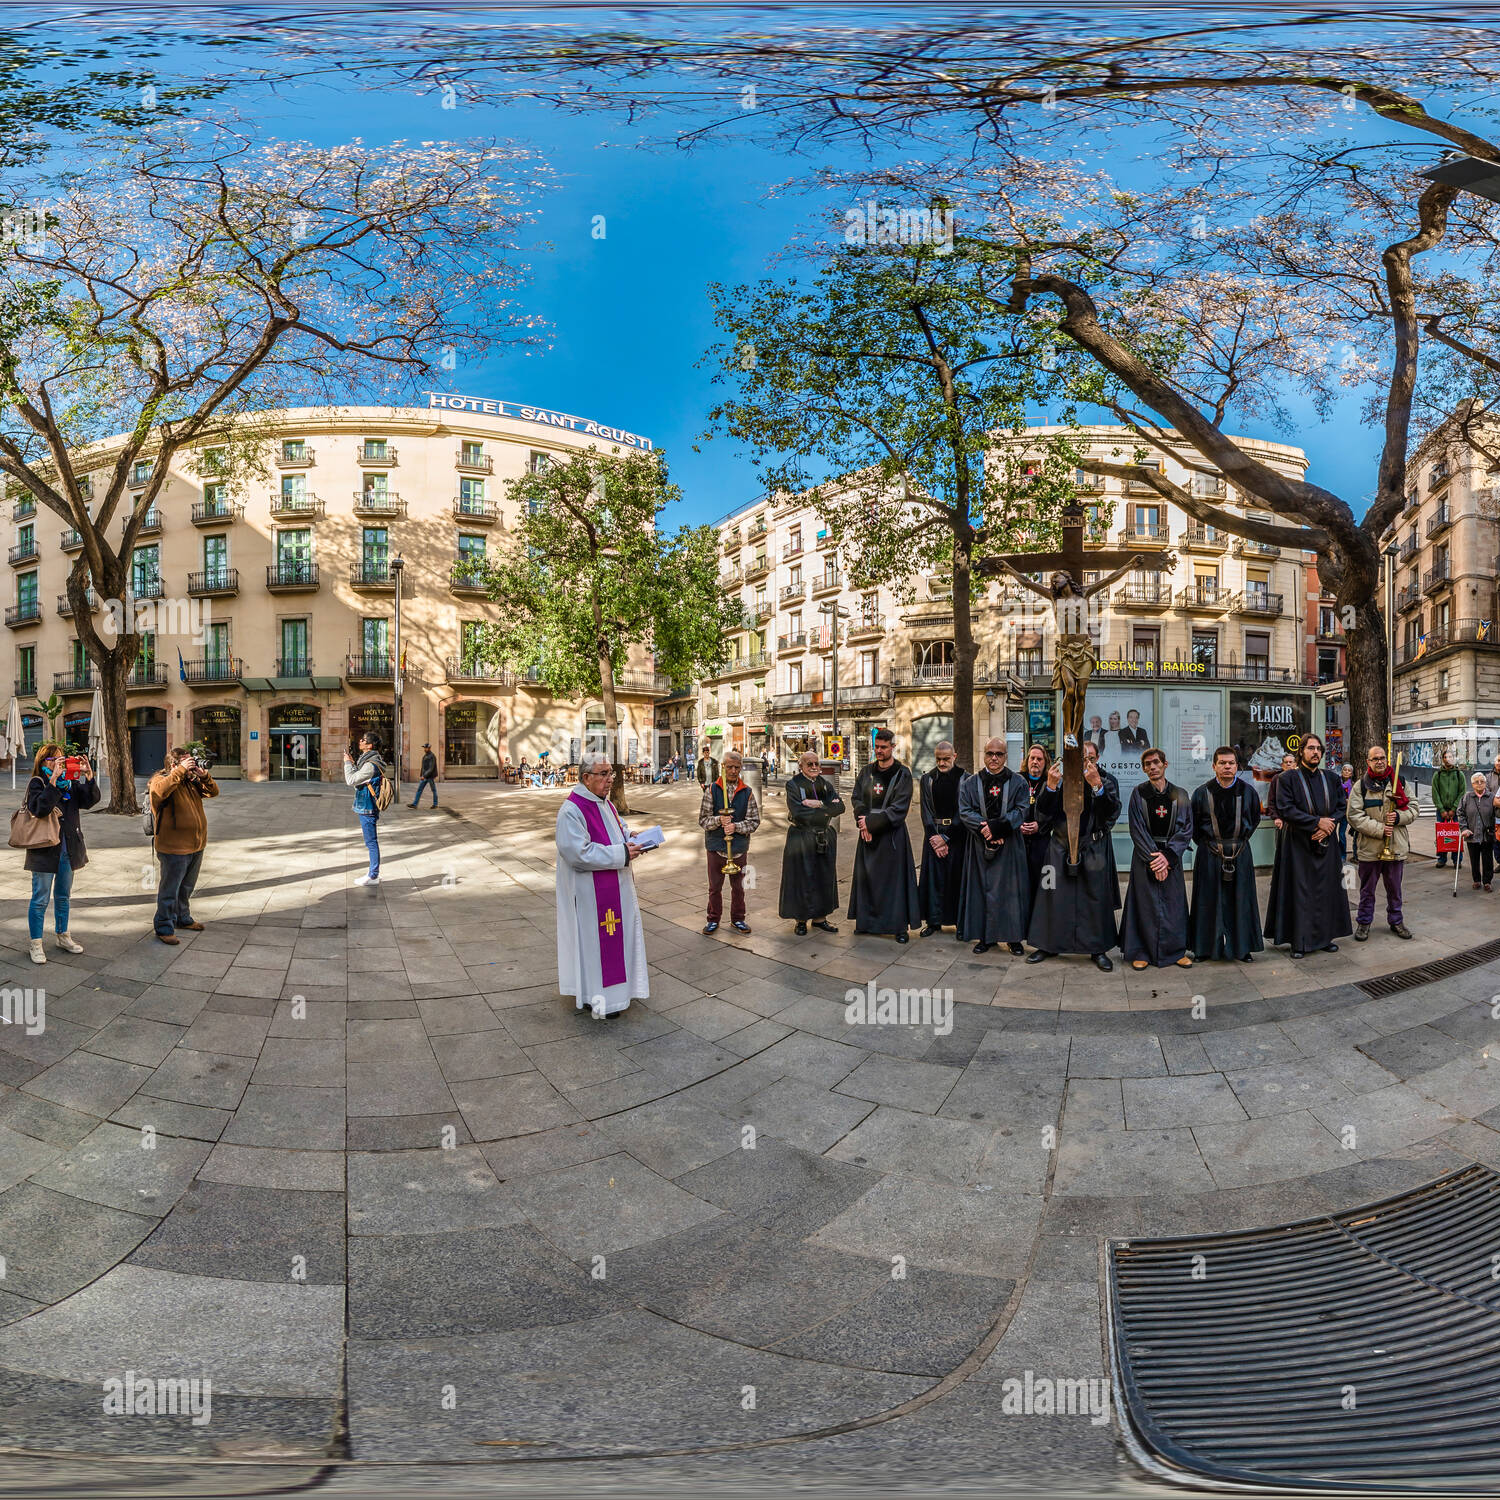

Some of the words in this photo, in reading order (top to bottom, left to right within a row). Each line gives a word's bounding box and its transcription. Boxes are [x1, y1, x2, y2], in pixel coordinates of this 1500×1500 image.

[431, 395, 511, 416] HOTEL
[520, 407, 579, 430] SANT
[1163, 661, 1206, 673] RAMOS
[1250, 705, 1293, 724] PLAISIR
[1111, 762, 1141, 770] GESTO
